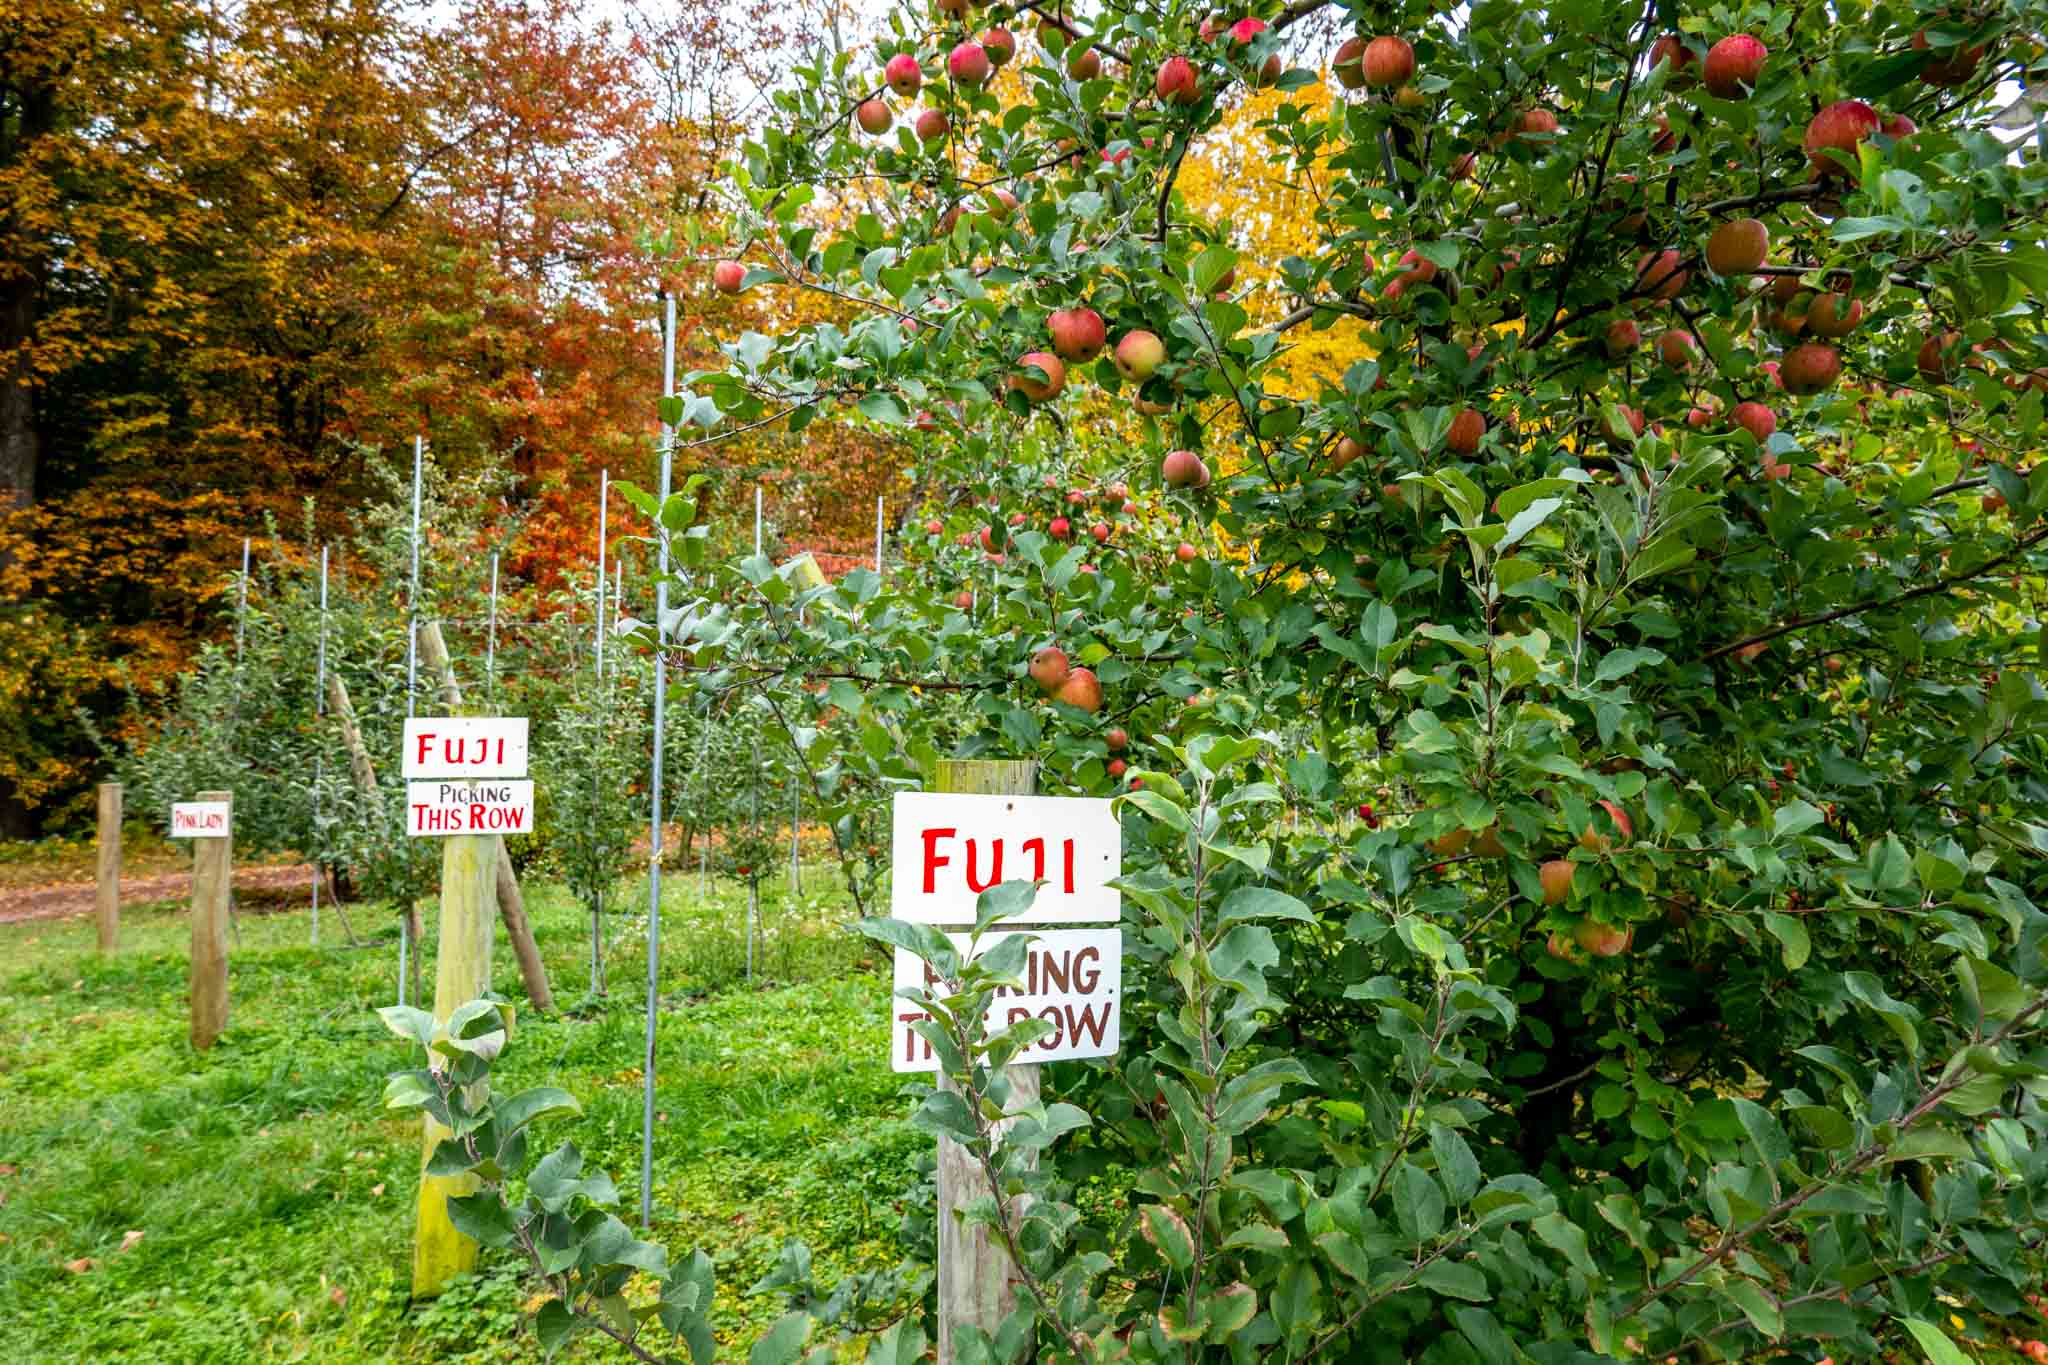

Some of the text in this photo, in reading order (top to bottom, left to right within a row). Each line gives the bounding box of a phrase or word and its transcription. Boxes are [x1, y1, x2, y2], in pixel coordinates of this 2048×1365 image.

[416, 733, 505, 765] FUJI
[439, 784, 512, 803] PICKING
[411, 803, 525, 831] THIS ROW
[920, 827, 1076, 894] FUJI
